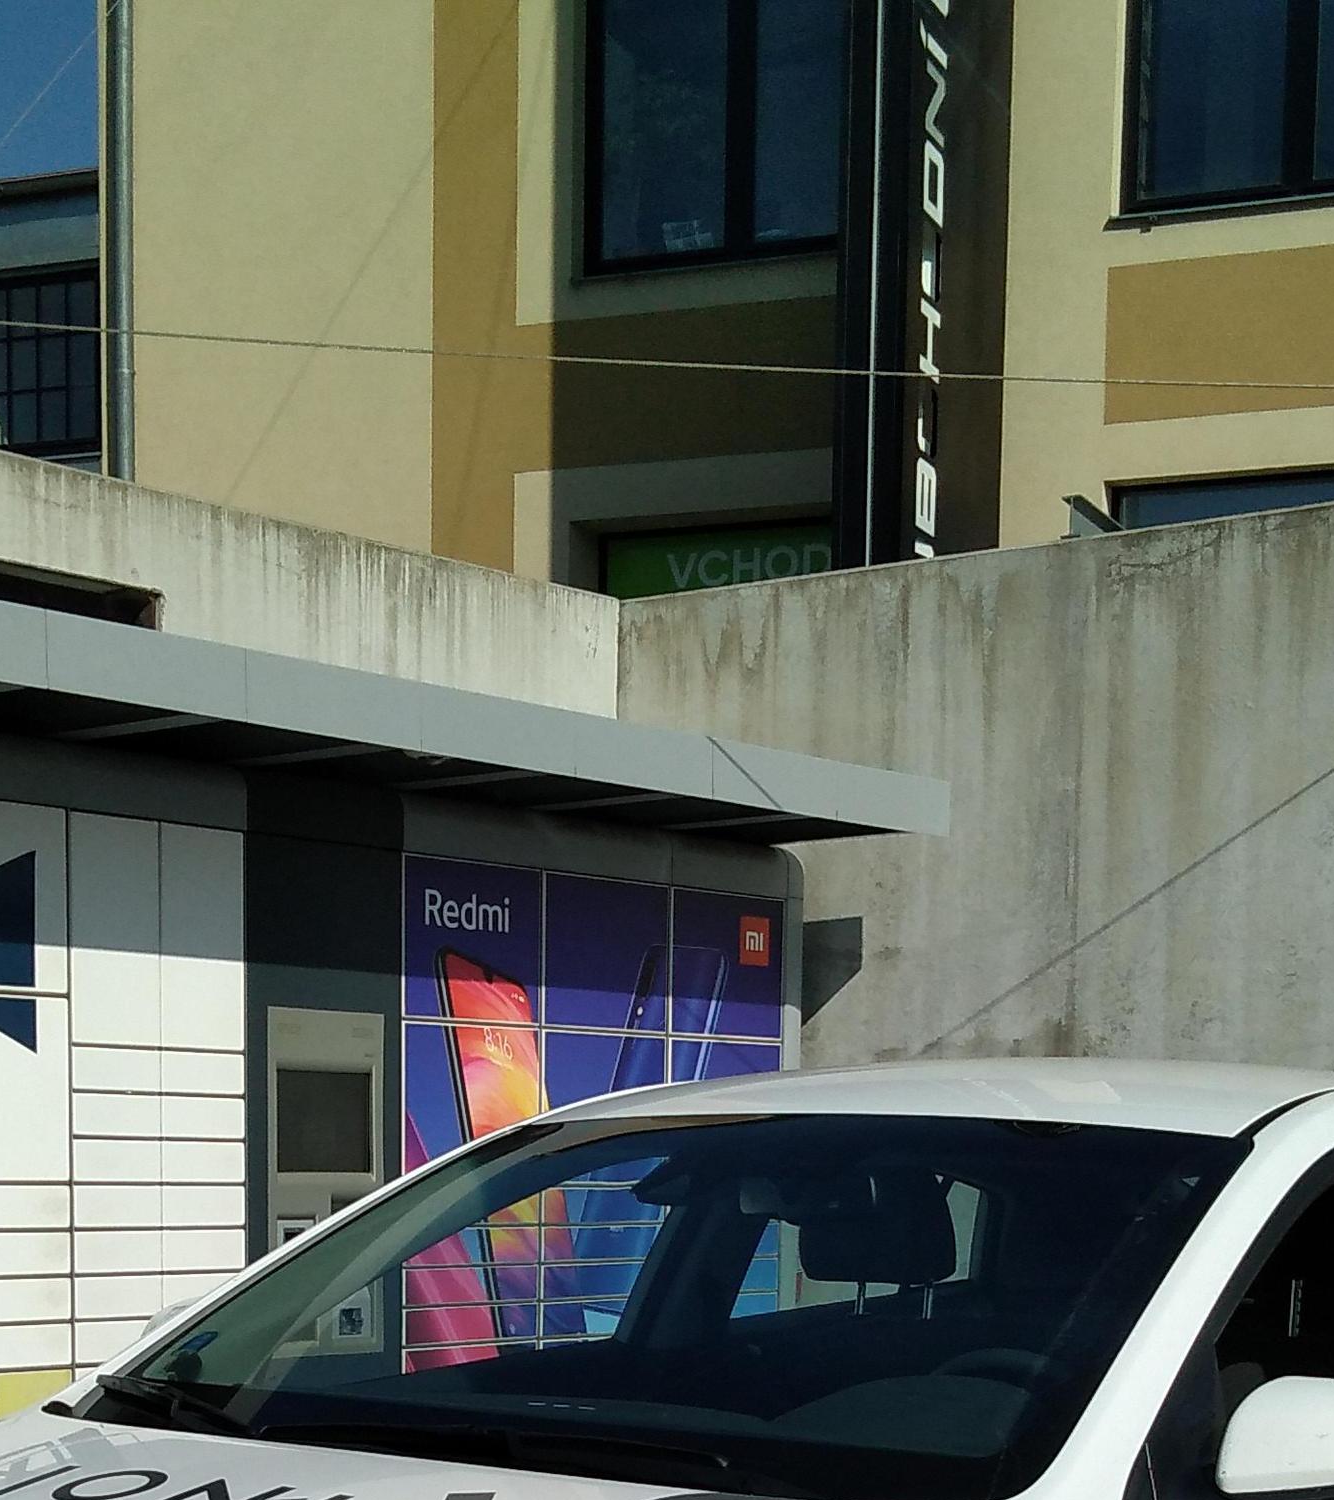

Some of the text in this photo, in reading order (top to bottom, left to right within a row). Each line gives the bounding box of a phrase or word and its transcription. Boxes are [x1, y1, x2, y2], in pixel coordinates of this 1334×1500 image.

[914, 18, 948, 558] BCHODNÍ
[424, 888, 510, 934] Redmi
[483, 1026, 513, 1061] 8:16
